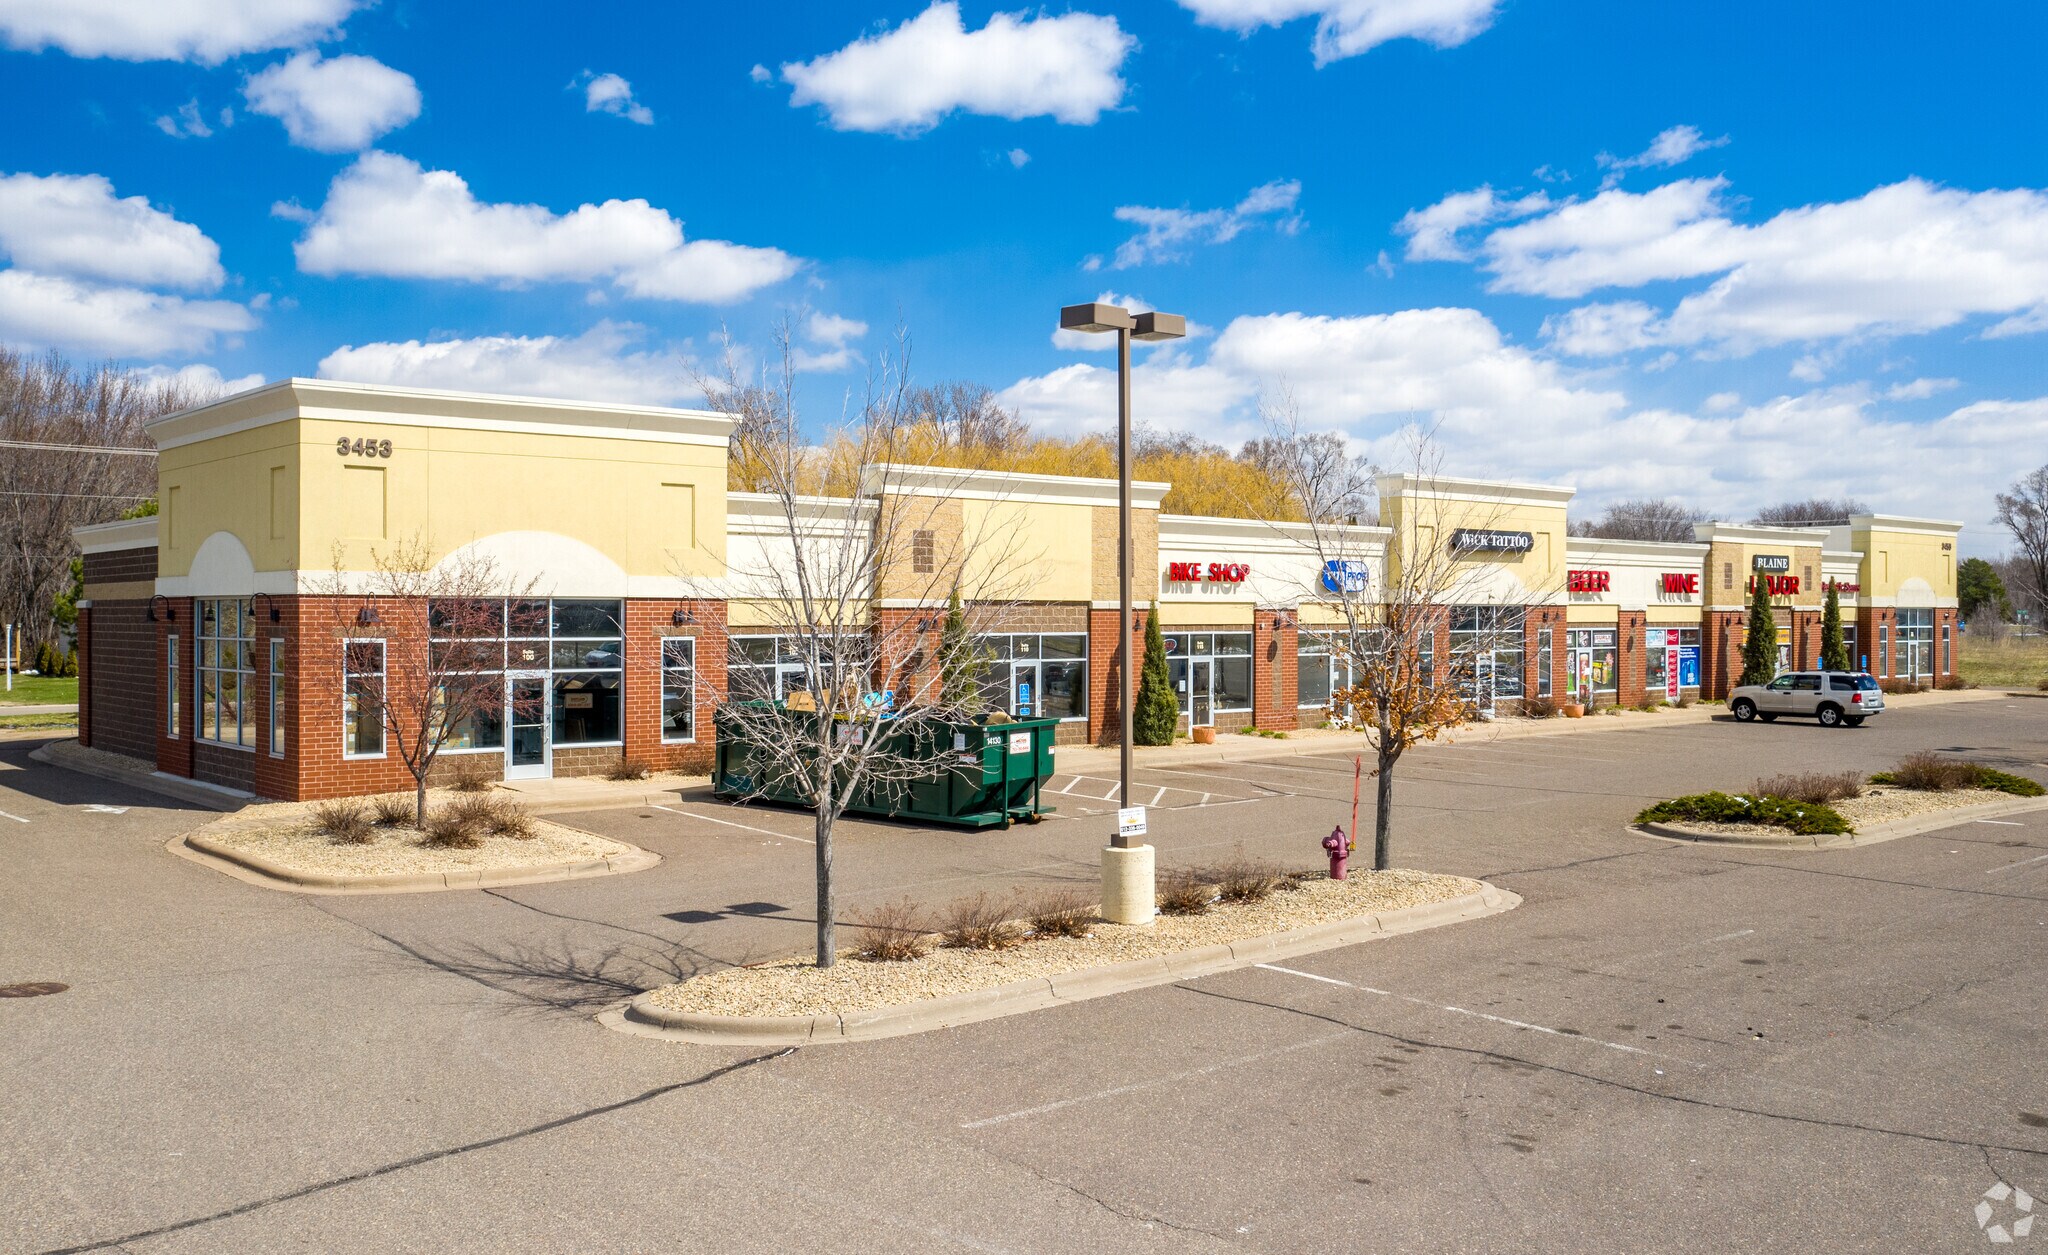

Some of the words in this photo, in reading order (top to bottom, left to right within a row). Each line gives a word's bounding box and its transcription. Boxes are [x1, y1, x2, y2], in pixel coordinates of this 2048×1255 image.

[336, 436, 393, 459] 3453
[1169, 562, 1202, 582] BIKE
[1208, 562, 1251, 582] SHOP
[1757, 557, 1788, 569] BLAINE
[1567, 570, 1611, 592] BEER
[1661, 573, 1699, 593] WINE
[1749, 574, 1800, 596] LQUOR
[986, 736, 1003, 746] 14130
